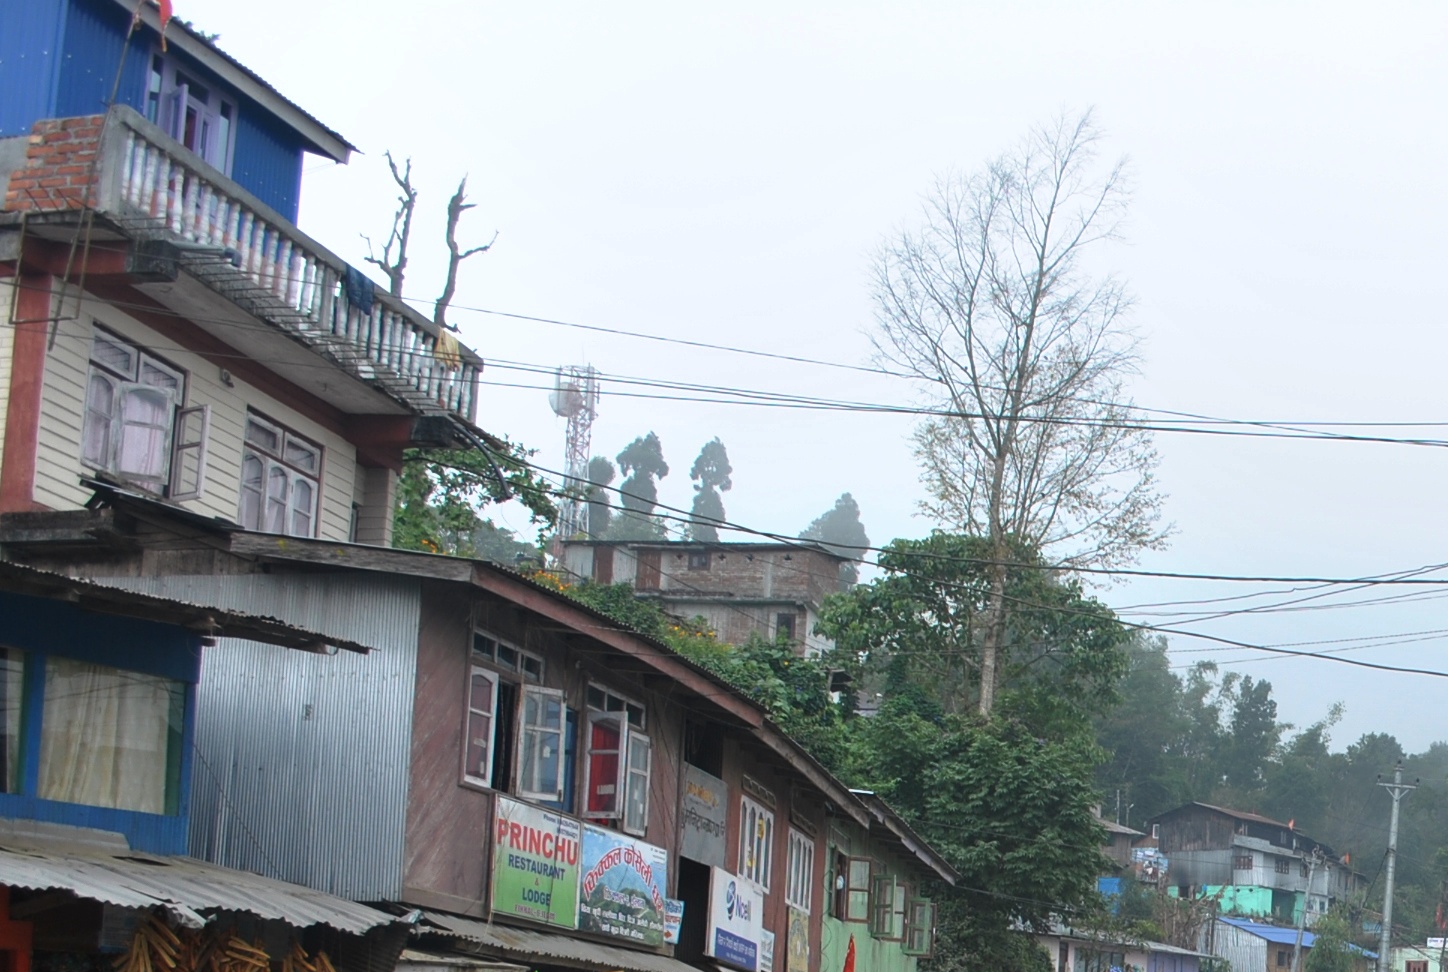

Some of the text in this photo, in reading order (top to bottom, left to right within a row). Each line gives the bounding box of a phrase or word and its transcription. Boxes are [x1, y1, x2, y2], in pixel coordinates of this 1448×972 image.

[497, 818, 579, 866] PRINCHU
[508, 853, 566, 881] RESTAURANT
[522, 887, 551, 907] LODGE
[735, 894, 752, 922] Ncell
